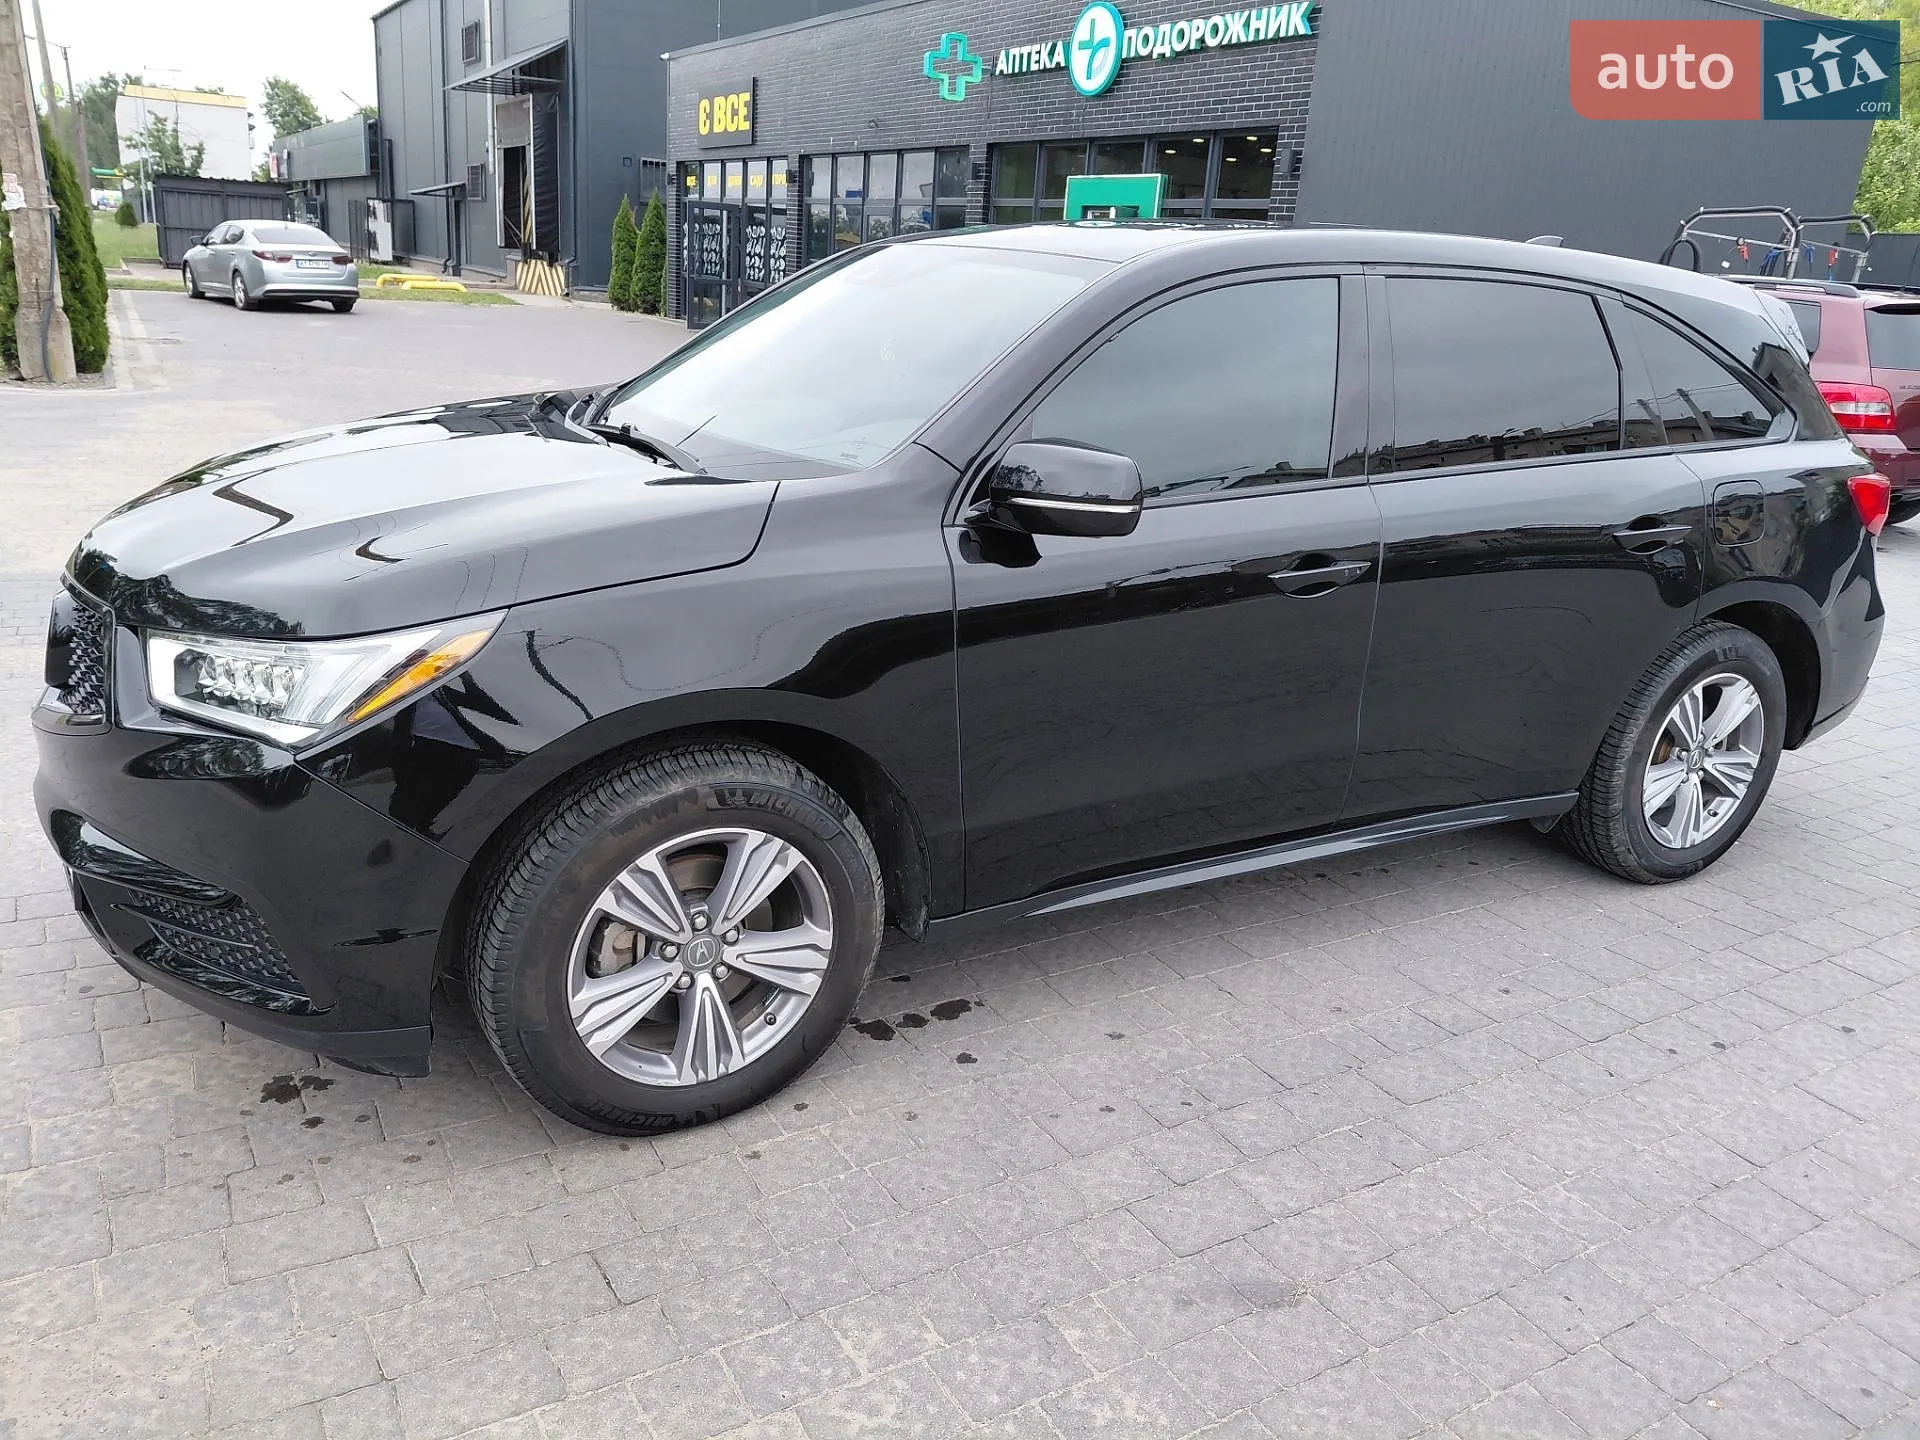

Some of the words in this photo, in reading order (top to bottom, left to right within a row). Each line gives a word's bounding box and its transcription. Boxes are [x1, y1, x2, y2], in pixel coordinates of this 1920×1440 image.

[995, 41, 1066, 75] АПТЕКА
[1122, 2, 1313, 58] ПОДОРОЖНИК
[698, 98, 710, 136] Є
[713, 92, 750, 133] ВСЕ
